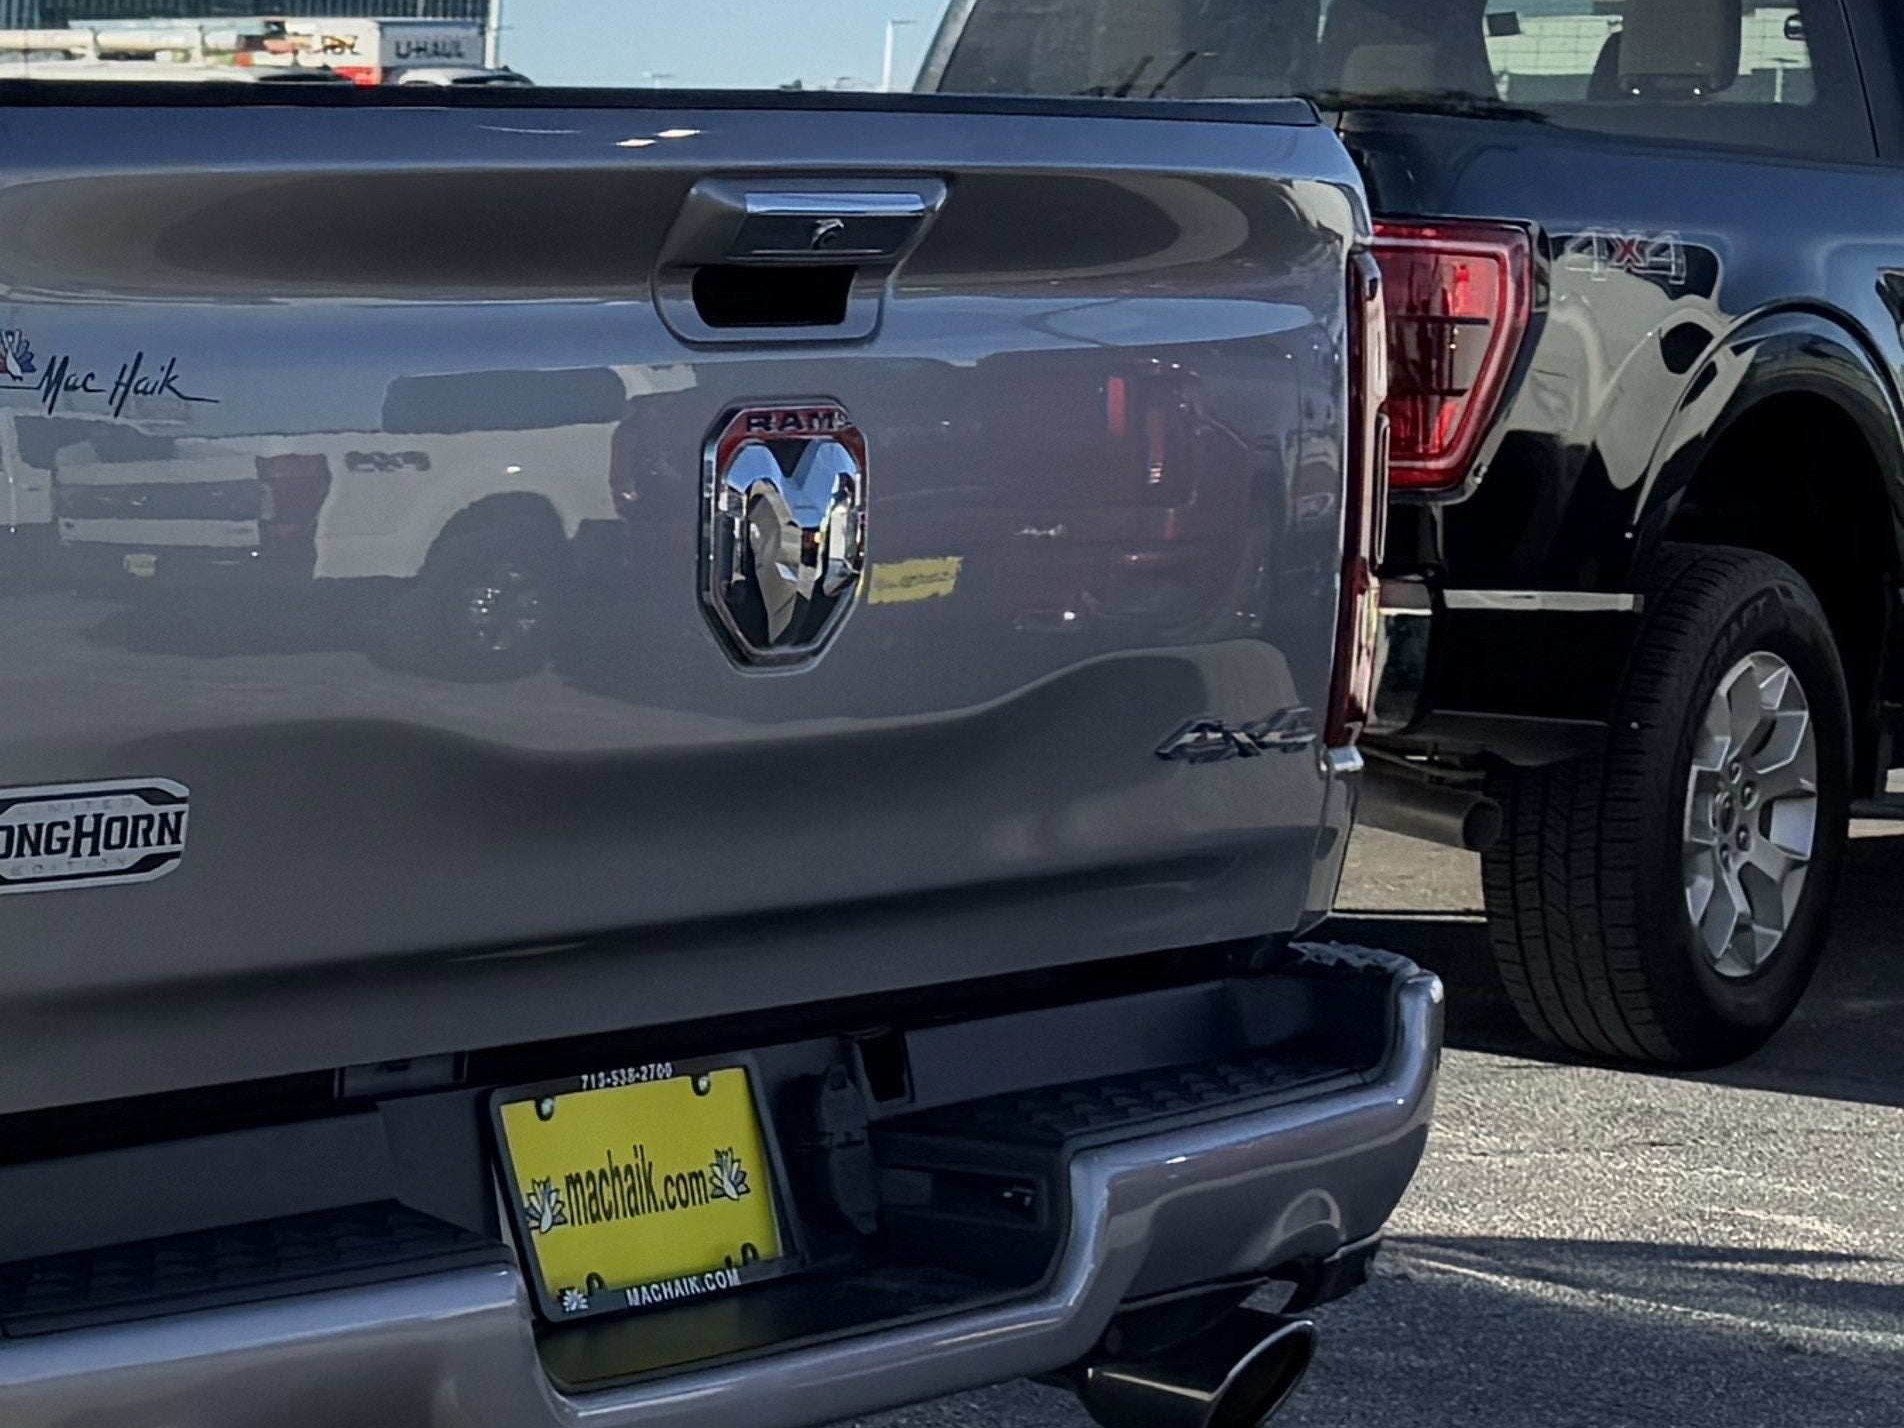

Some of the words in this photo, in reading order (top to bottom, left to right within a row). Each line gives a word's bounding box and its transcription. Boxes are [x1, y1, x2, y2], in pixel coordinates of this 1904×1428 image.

[108, 351, 220, 418] Haik
[747, 409, 840, 433] RAM
[563, 1144, 709, 1227] machaik.com
[625, 1268, 741, 1307] MACHAIK.COM
